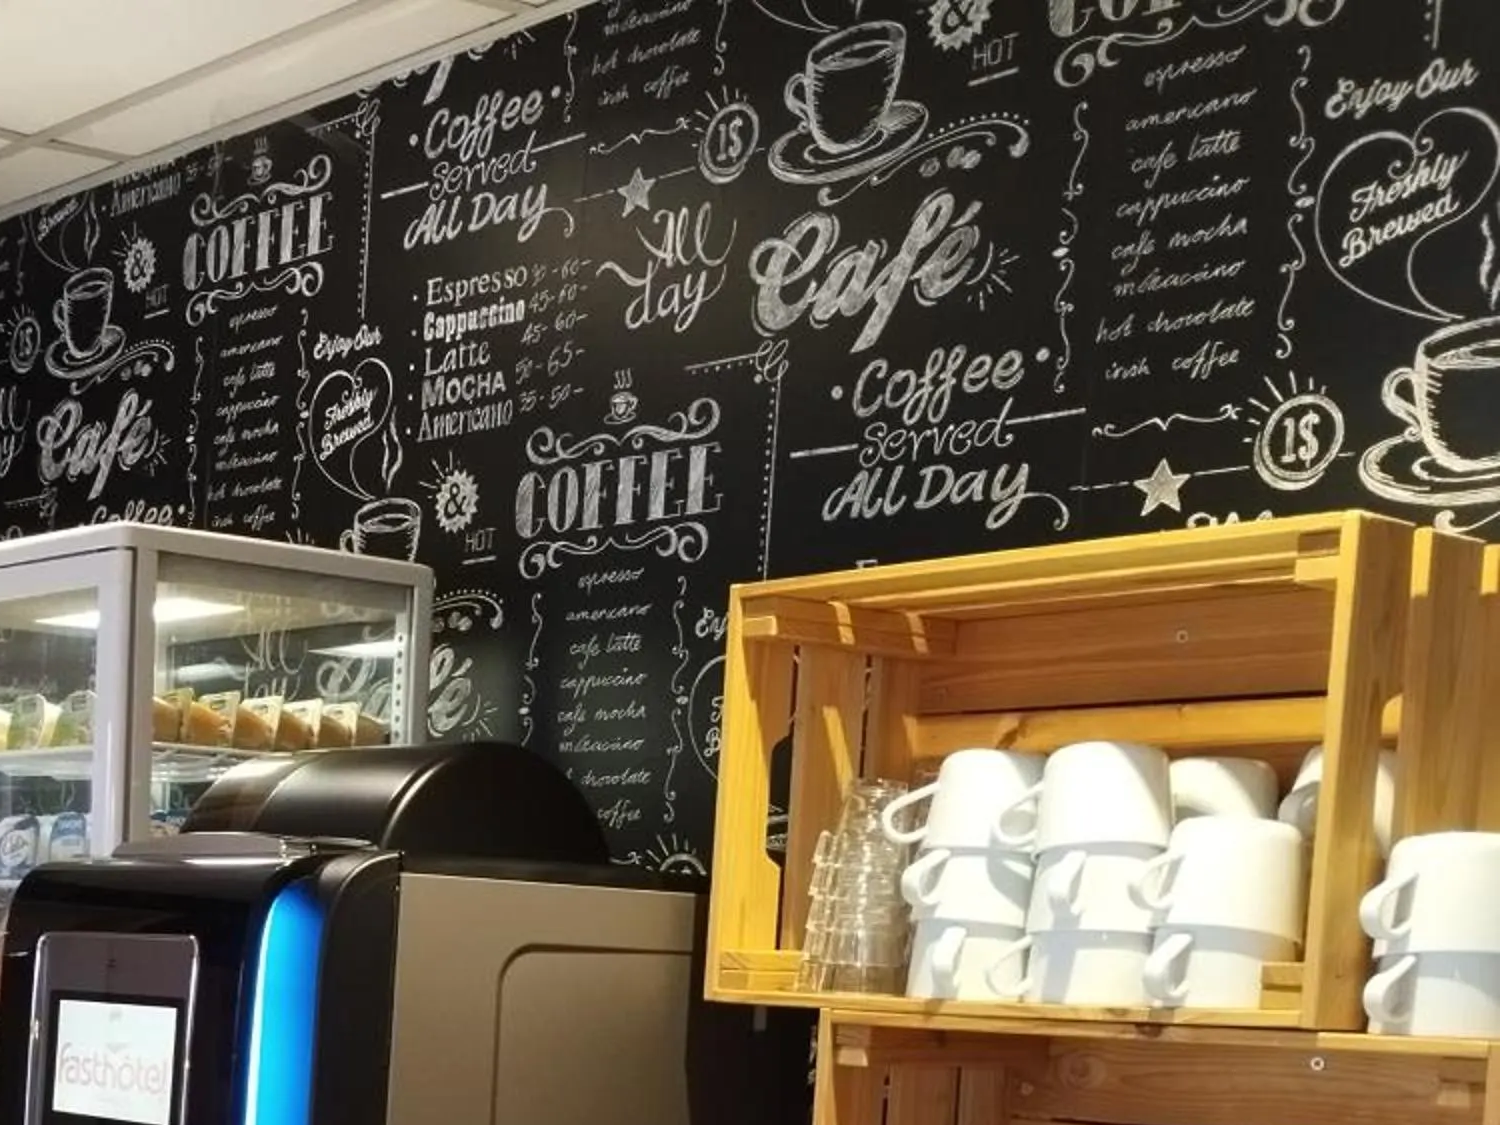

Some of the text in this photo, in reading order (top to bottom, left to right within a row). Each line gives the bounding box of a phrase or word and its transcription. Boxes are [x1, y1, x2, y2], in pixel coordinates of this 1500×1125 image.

[972, 33, 1019, 70] HOT
[1125, 87, 1258, 131] americano
[1324, 57, 1480, 120] Enjoy Our
[424, 88, 543, 163] Coffee
[1188, 129, 1242, 161] latte
[429, 130, 537, 200] Served
[1350, 150, 1469, 223] Freshly
[403, 183, 548, 250] All Day
[1116, 175, 1251, 227] cappuccino
[1339, 187, 1461, 268] Brewed
[183, 191, 334, 290] COFFEE
[1168, 213, 1249, 249] mocha
[426, 266, 527, 307] Espresso
[749, 188, 984, 352] Café
[423, 296, 526, 342] Cappuccino
[1096, 313, 1135, 345] hot
[424, 341, 491, 377] Latte
[852, 343, 1025, 425] Coffee
[1171, 340, 1240, 380] coffee
[421, 370, 507, 412] MOCHA
[37, 387, 153, 500] Café
[417, 399, 513, 442] Americano
[859, 397, 1014, 467] Served
[515, 441, 724, 539] COFFEE
[822, 463, 1030, 530] All Day
[465, 526, 497, 552] HOT
